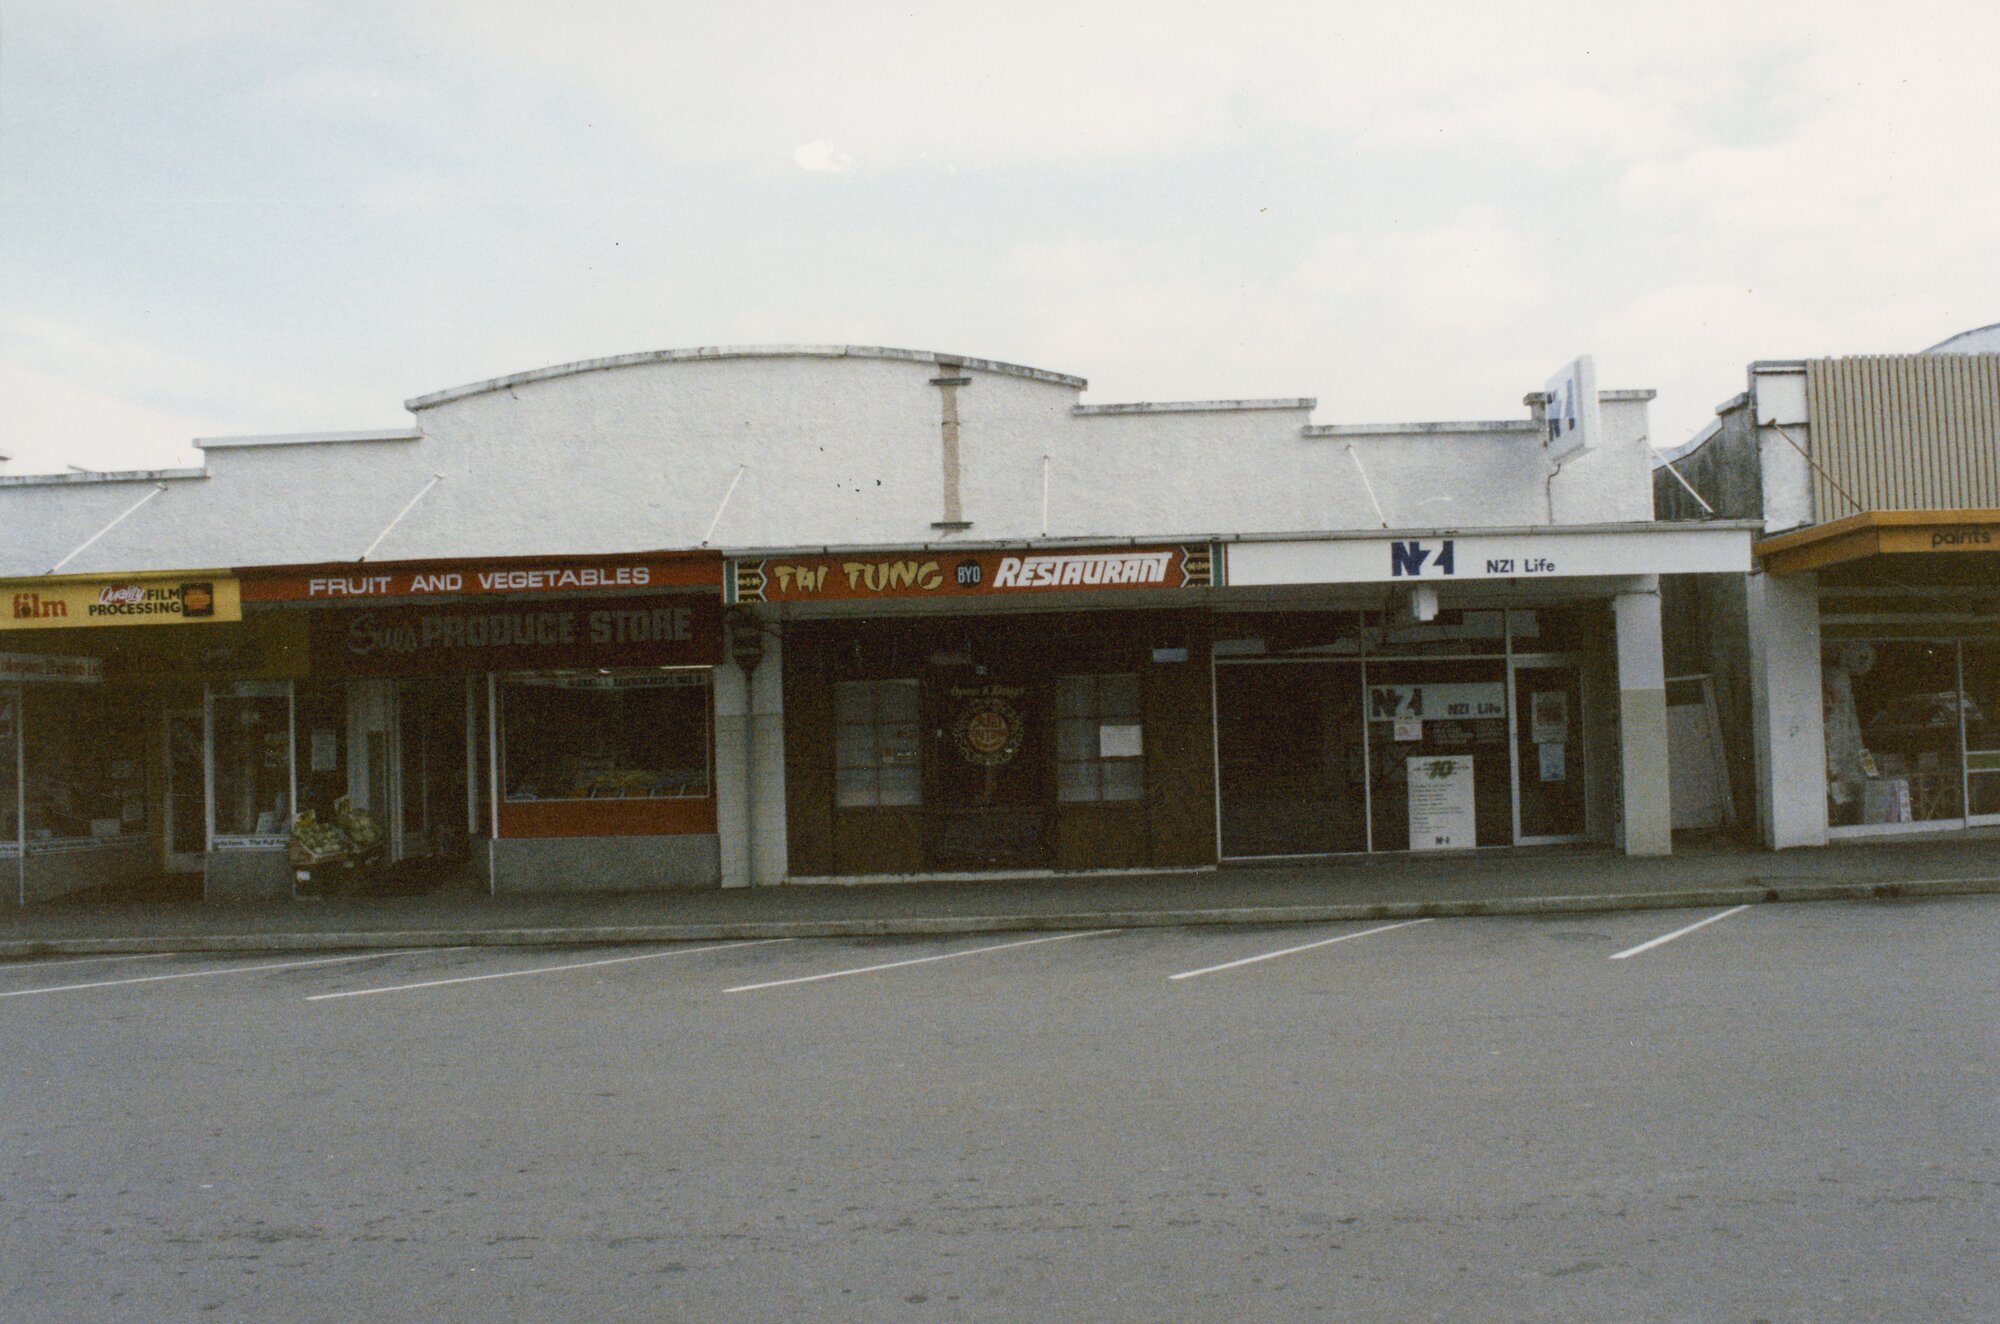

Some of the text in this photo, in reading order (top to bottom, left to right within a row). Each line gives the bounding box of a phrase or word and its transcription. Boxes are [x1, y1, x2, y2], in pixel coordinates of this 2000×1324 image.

[1931, 527, 1992, 549] paints
[992, 552, 1174, 588] RESTAURANT
[1391, 540, 1454, 577] NZI
[1486, 558, 1556, 574] NZI Life
[309, 567, 651, 596] FRUIT AND VEGETABLES
[773, 560, 944, 595] TAI TUNG
[957, 565, 981, 584] BYO
[13, 592, 68, 619] film
[97, 584, 182, 606] Quality FILM
[88, 601, 182, 617] PROCESSING
[421, 612, 575, 649] PRODUCE
[588, 608, 693, 644] STORE
[1370, 687, 1423, 718] NZI
[1448, 702, 1502, 715] NZI Life
